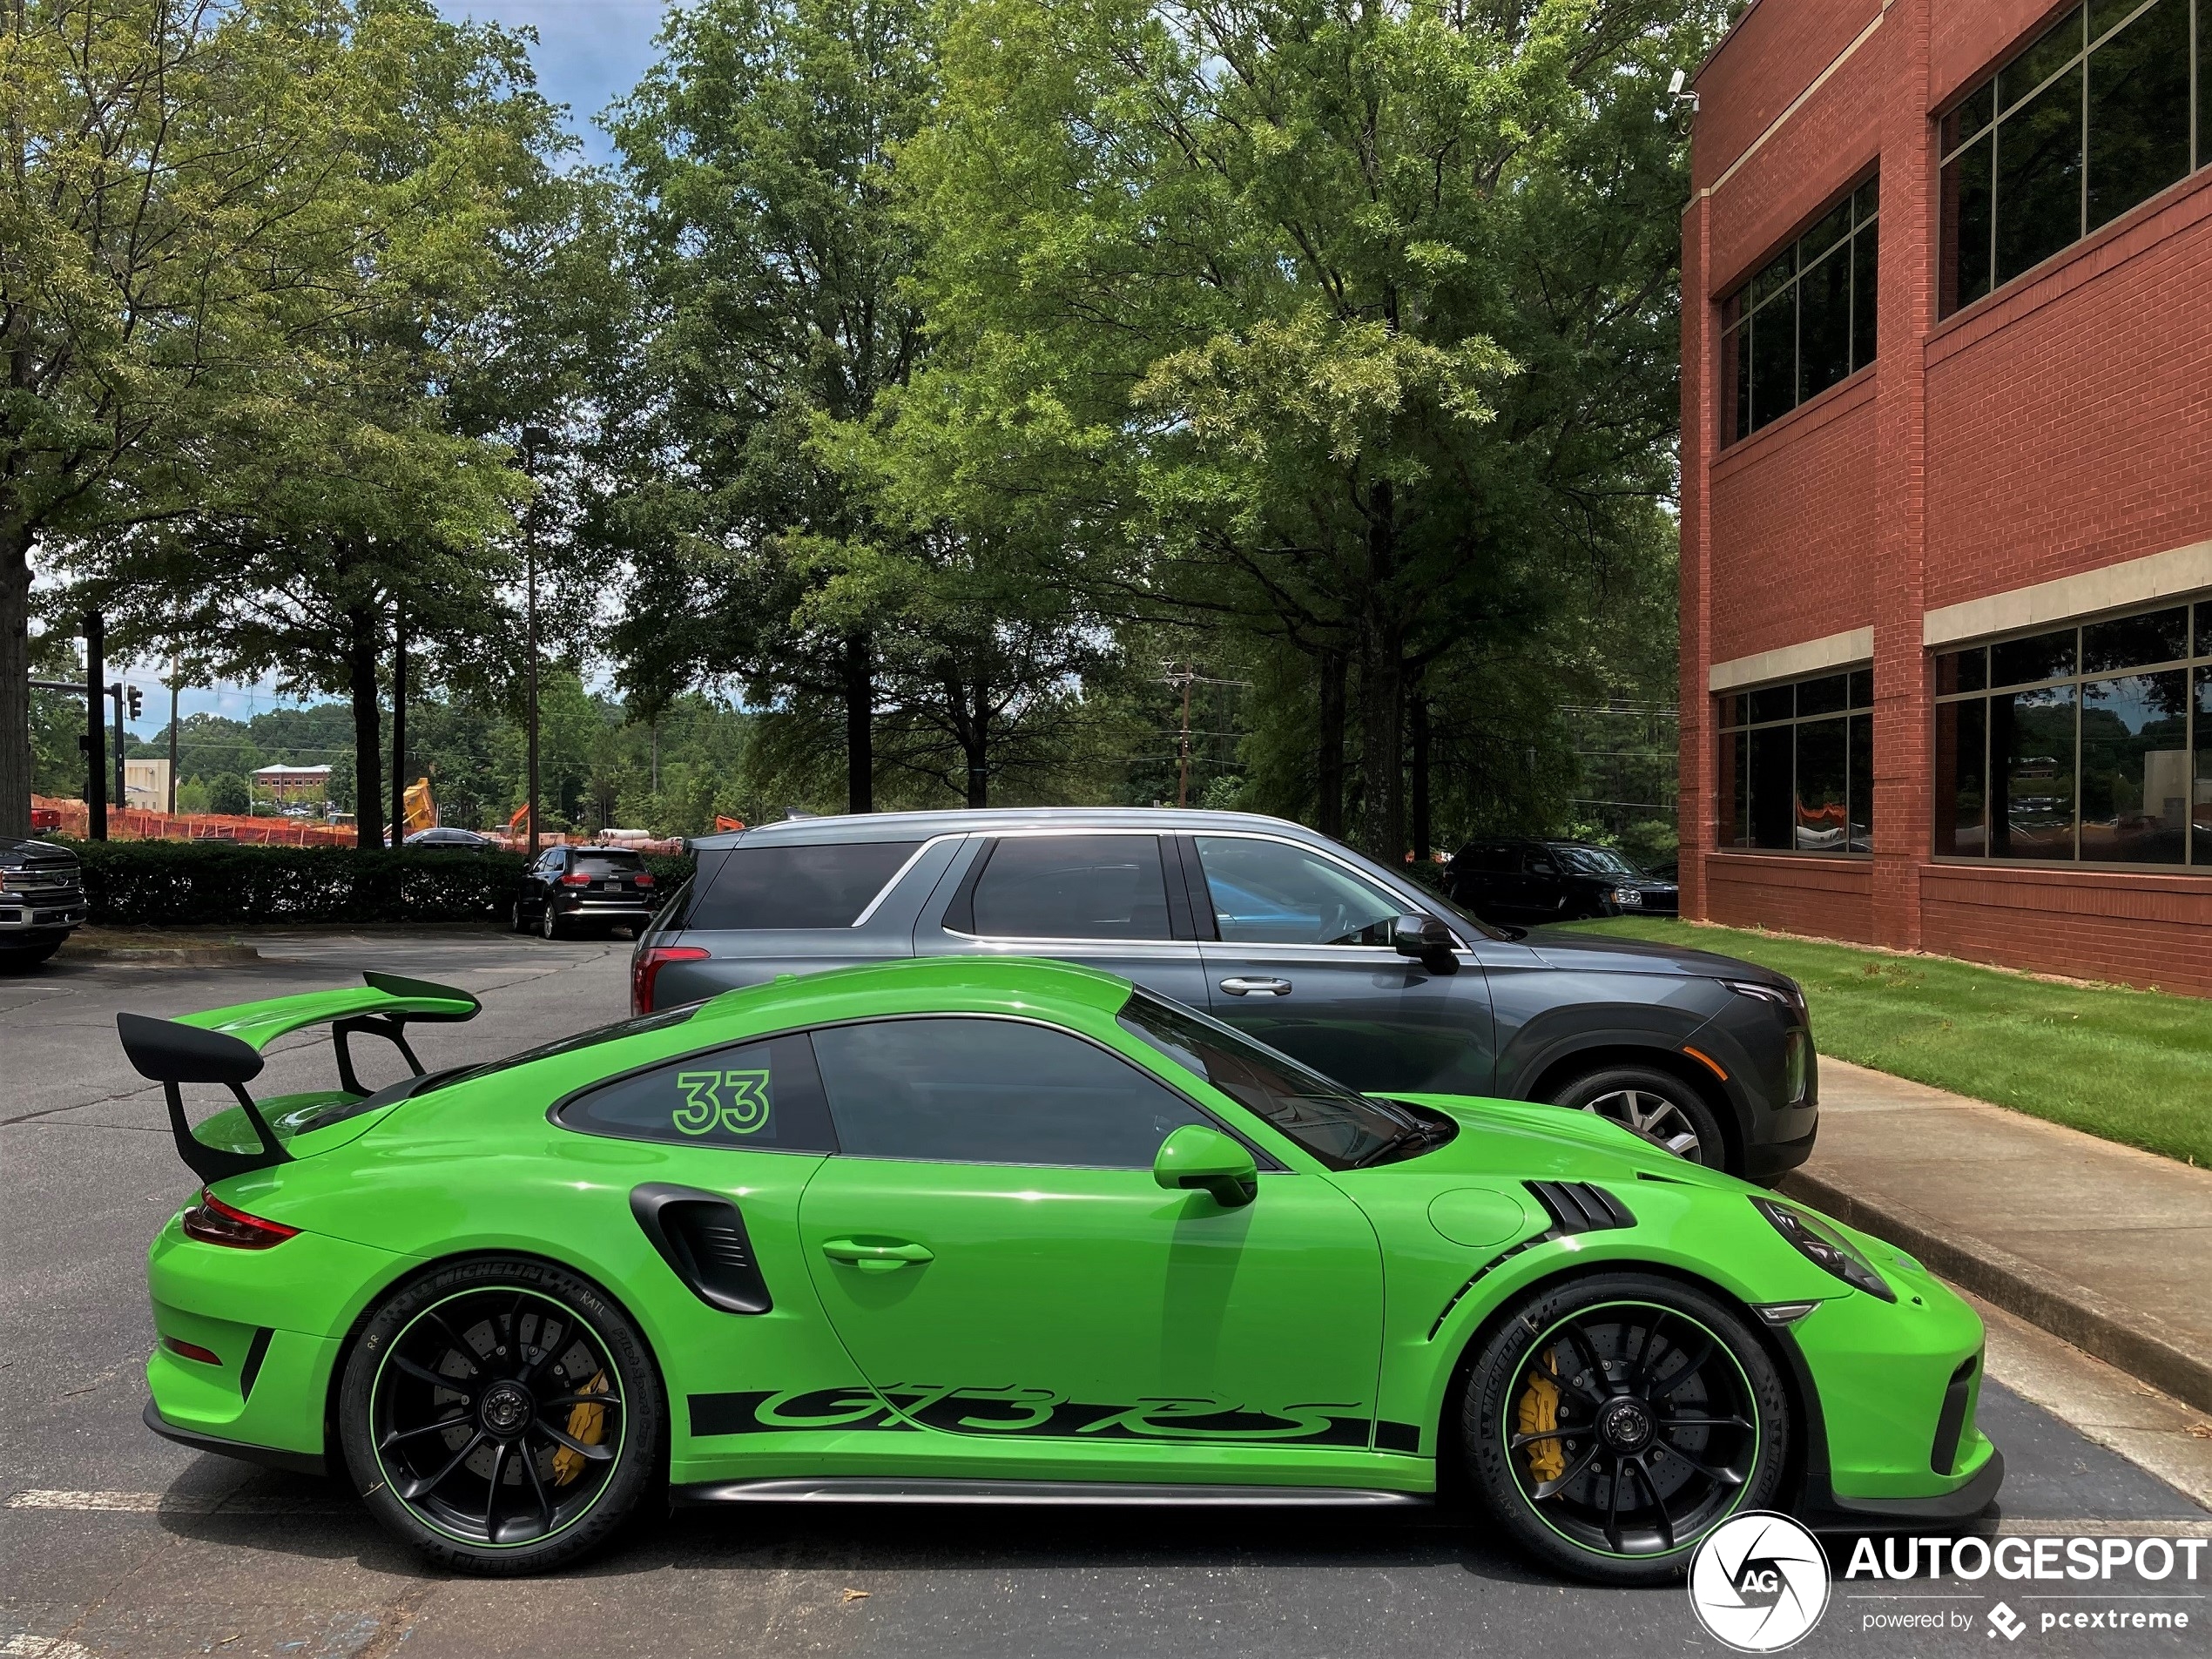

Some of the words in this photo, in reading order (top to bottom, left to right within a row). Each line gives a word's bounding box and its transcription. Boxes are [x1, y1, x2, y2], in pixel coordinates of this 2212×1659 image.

[672, 1069, 770, 1136] 33
[435, 1262, 543, 1289] MICHELIN
[580, 1290, 606, 1317] RATL
[367, 1333, 381, 1350] RR
[1482, 1326, 1527, 1413] MICHELIN
[754, 1384, 1069, 1433] GT3
[1076, 1397, 1362, 1438] RS
